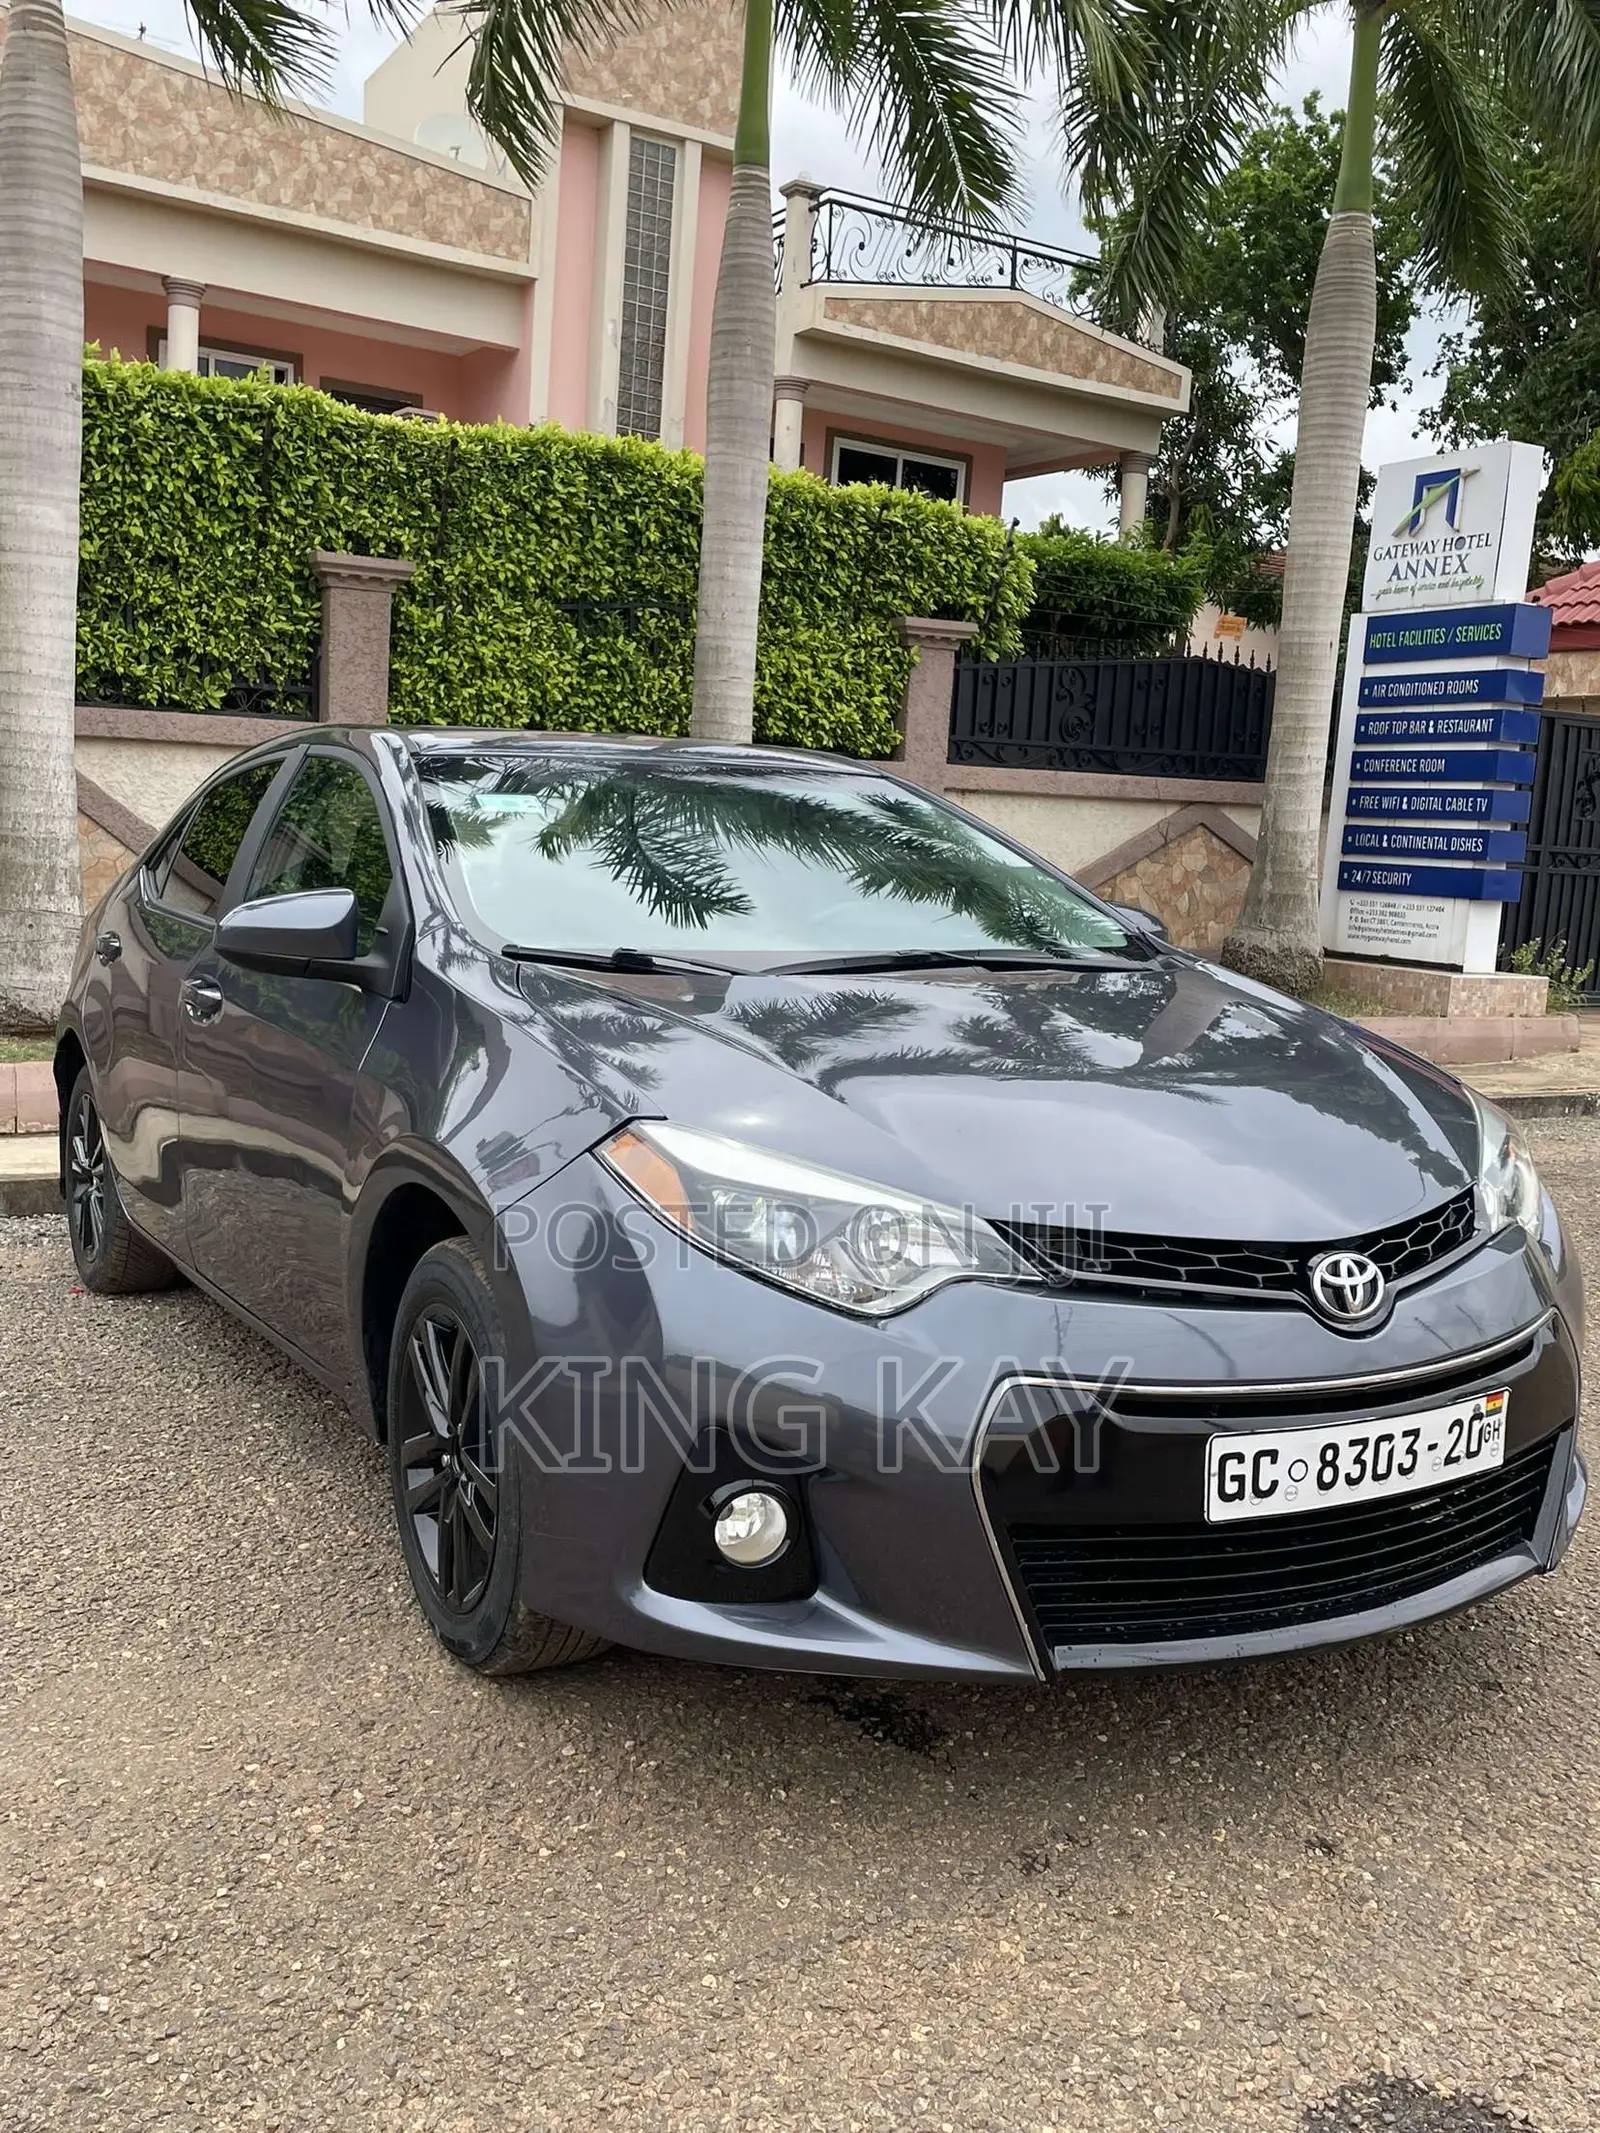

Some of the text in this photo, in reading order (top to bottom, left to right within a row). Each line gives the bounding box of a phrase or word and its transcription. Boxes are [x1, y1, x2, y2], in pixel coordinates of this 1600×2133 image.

[1373, 532, 1493, 562] GATEWAY HOTEL
[1387, 553, 1470, 582] ANNEX
[1369, 623, 1503, 649] HOTEL FACILITIES / SERVICES
[1371, 679, 1480, 698] AIR CONDITIONED ROOMS
[1368, 718, 1495, 735] ROOF TOP BAR & RESTAURANT
[1363, 758, 1446, 773] CONFERENCE ROOM
[1359, 795, 1489, 813] FREE WIFI & DIGITAL CABLE TV
[1355, 833, 1484, 853] LOCAL & CONTINENTAL DISHES
[1350, 869, 1413, 886] 24/7 SECURITY
[1483, 1418, 1501, 1444] GH
[1217, 1448, 1280, 1503] GC
